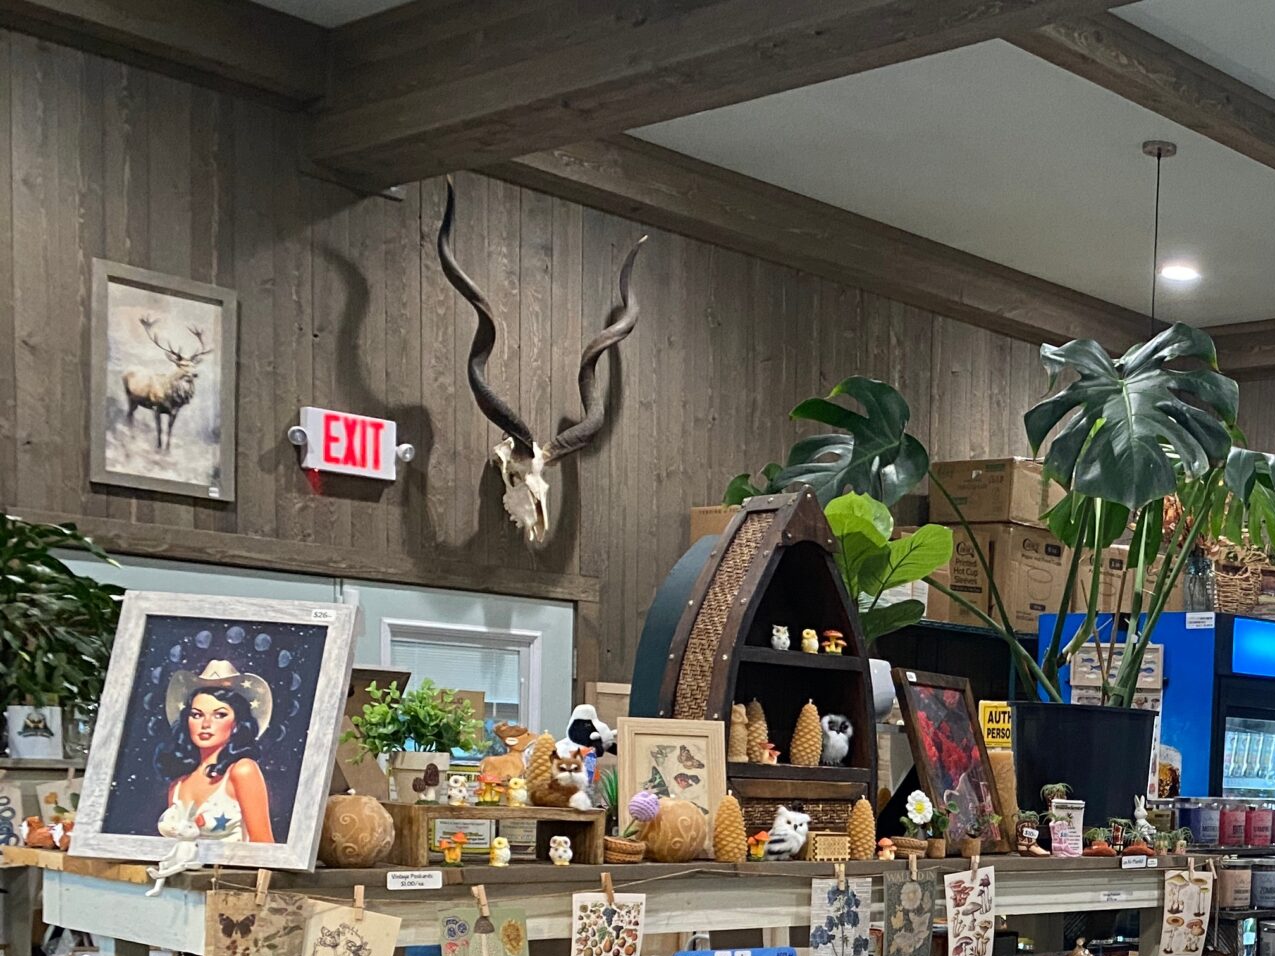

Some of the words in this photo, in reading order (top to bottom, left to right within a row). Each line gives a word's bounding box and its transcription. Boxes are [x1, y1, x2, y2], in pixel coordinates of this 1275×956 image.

[322, 412, 384, 471] EXIT
[954, 567, 965, 575] Hot
[965, 567, 978, 577] Cup
